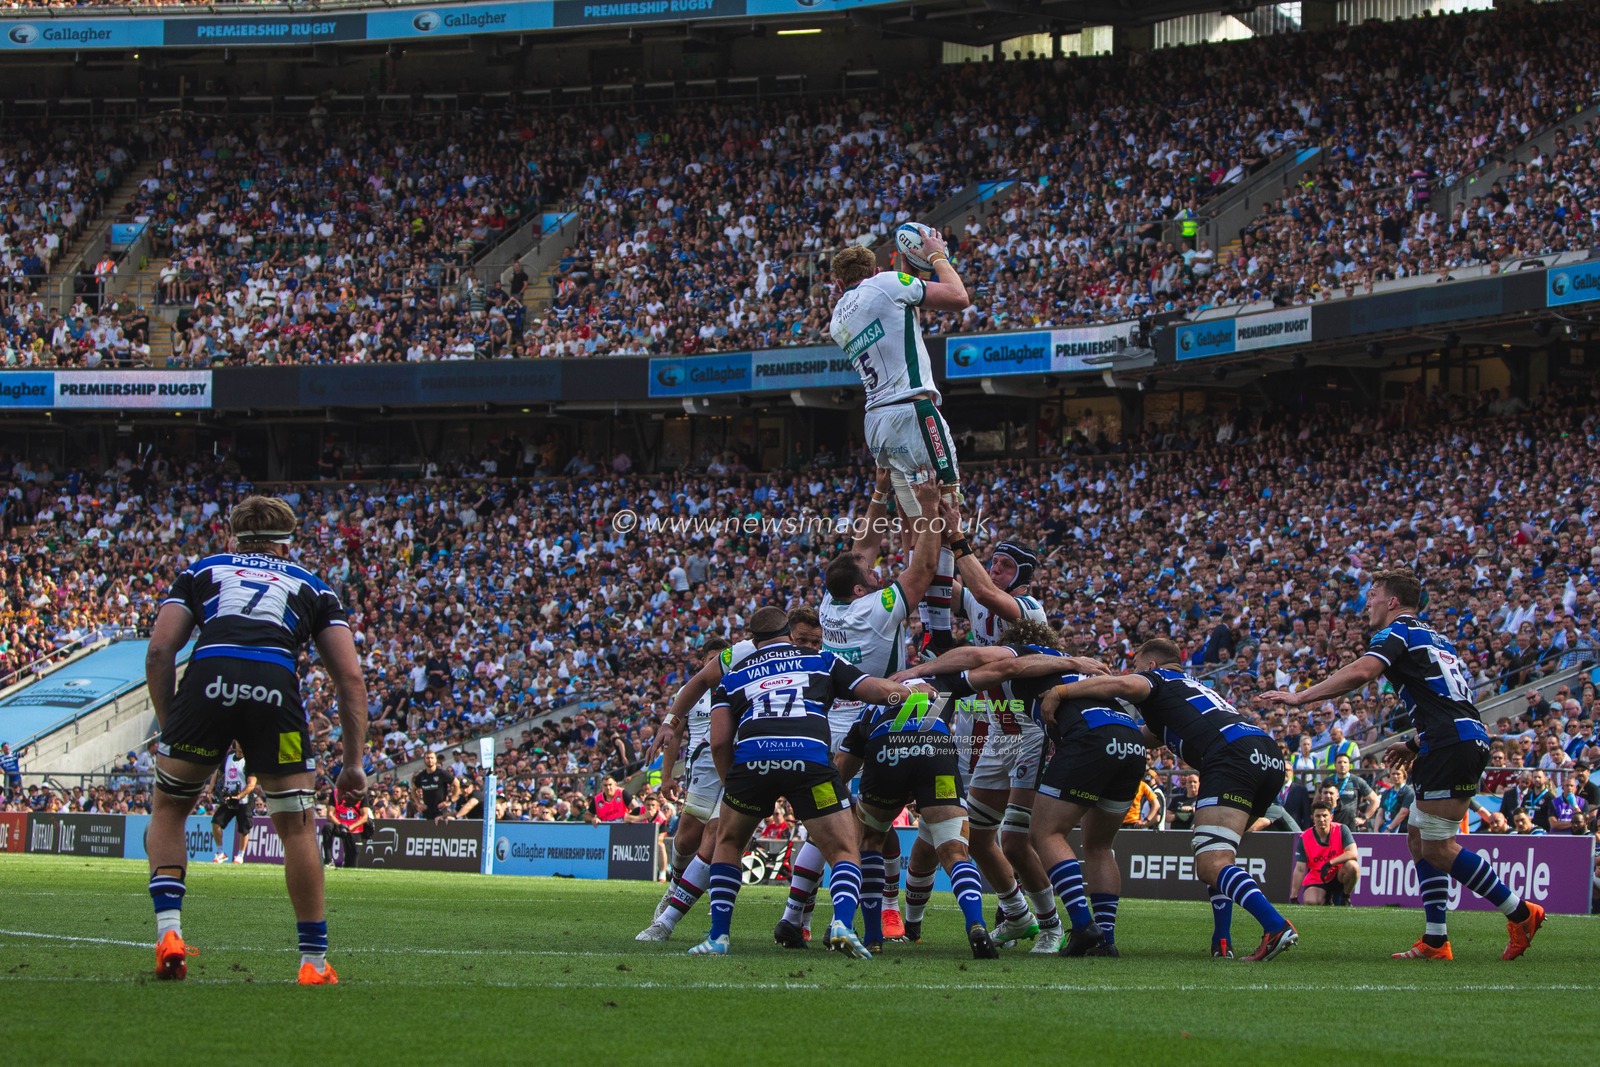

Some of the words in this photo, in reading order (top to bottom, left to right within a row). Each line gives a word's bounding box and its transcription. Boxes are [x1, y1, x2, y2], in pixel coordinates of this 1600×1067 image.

[584, 1, 669, 17] PREMIERSHIP
[671, 0, 714, 12] RUGBY
[197, 24, 289, 38] PREMIERSHIP
[291, 22, 337, 35] RUGBY
[443, 11, 507, 28] Gallagher
[42, 27, 112, 42] Gallagher
[1196, 331, 1232, 347] Gallagher
[1238, 322, 1284, 340] PREMIERSHIP
[1284, 318, 1309, 333] RUGBY
[983, 345, 1045, 364] Gallagher
[690, 367, 747, 384] Gallagher
[756, 359, 828, 377] PREMIERSHIP
[859, 352, 878, 390] 5
[60, 383, 155, 396] PREMIERSHIP
[158, 383, 207, 396] RUGBY
[929, 426, 944, 457] SPAR
[232, 557, 288, 572] PEPPER
[240, 580, 270, 615] 7
[746, 650, 801, 666] THATCHERS
[747, 665, 770, 680] VAN
[775, 660, 803, 673] WYK
[205, 675, 283, 707] dyson
[758, 689, 797, 717] 17
[877, 744, 934, 766] dyson
[1106, 738, 1146, 759] dyson
[1250, 749, 1285, 771] dyson
[31, 819, 54, 851] BUFFALO
[58, 820, 76, 853] TRACE
[405, 836, 477, 858] DEFENDER
[511, 843, 545, 862] Gallagher
[548, 847, 585, 860] PREMIERSHIP
[586, 848, 606, 860] RUGBY
[612, 845, 633, 861] FINAL
[634, 846, 650, 862] 2025
[1130, 855, 1266, 883] DEFEER
